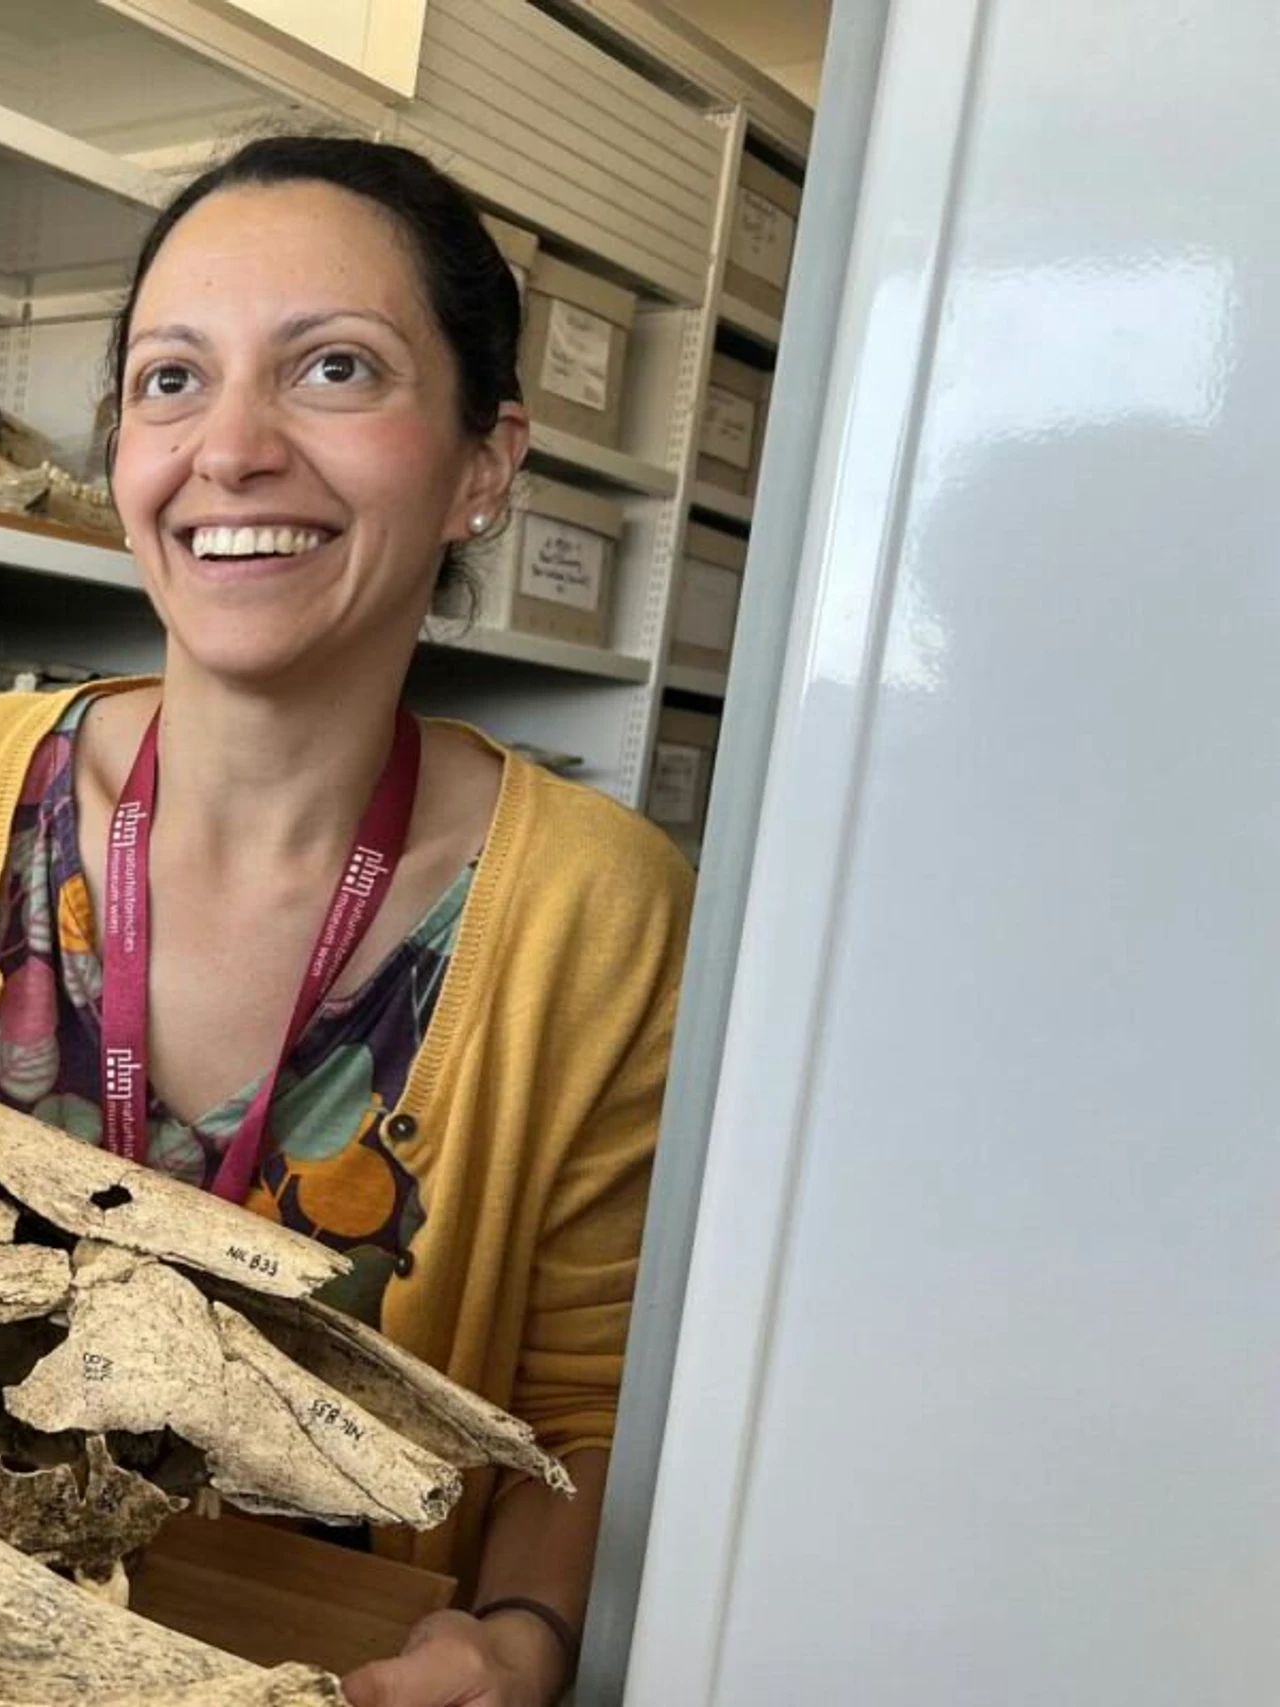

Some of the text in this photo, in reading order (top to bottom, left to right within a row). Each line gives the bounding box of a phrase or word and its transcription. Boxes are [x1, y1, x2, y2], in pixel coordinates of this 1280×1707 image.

[111, 801, 147, 848] nhm
[341, 846, 388, 897] nhm
[106, 1047, 142, 1100] nhm
[122, 1101, 135, 1158] naturhist
